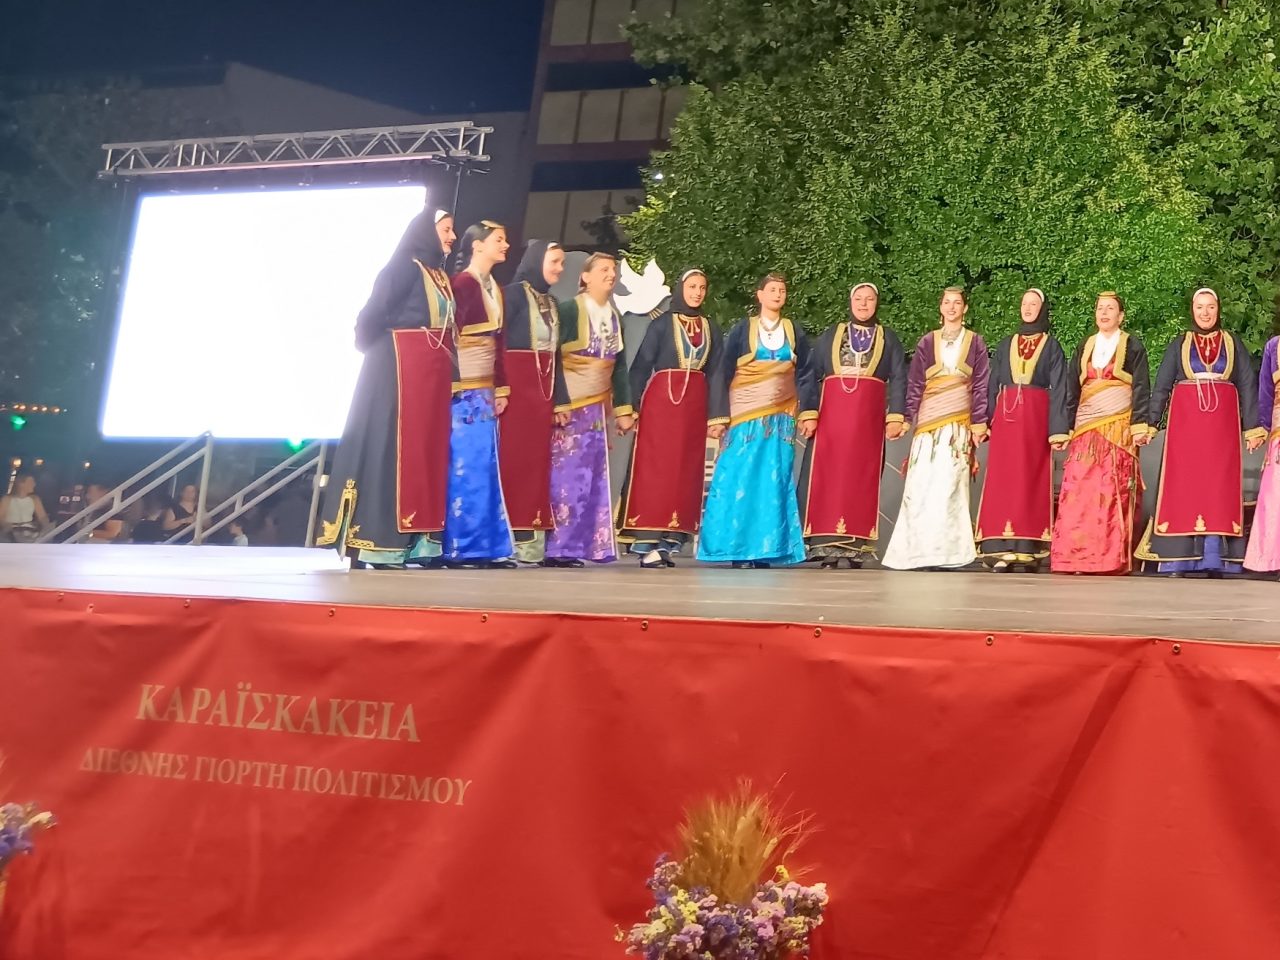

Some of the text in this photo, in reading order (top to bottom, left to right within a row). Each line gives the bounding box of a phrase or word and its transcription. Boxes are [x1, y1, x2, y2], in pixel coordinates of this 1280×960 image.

[135, 682, 421, 742] ΚΑΡΑΪΣΚΑΚΕΙΑ
[79, 745, 473, 806] ΔΙΕΘΝΗΣ ΓΙΟΡΤΗ ΠΟΛΙΤΙΣΜΟΥ
